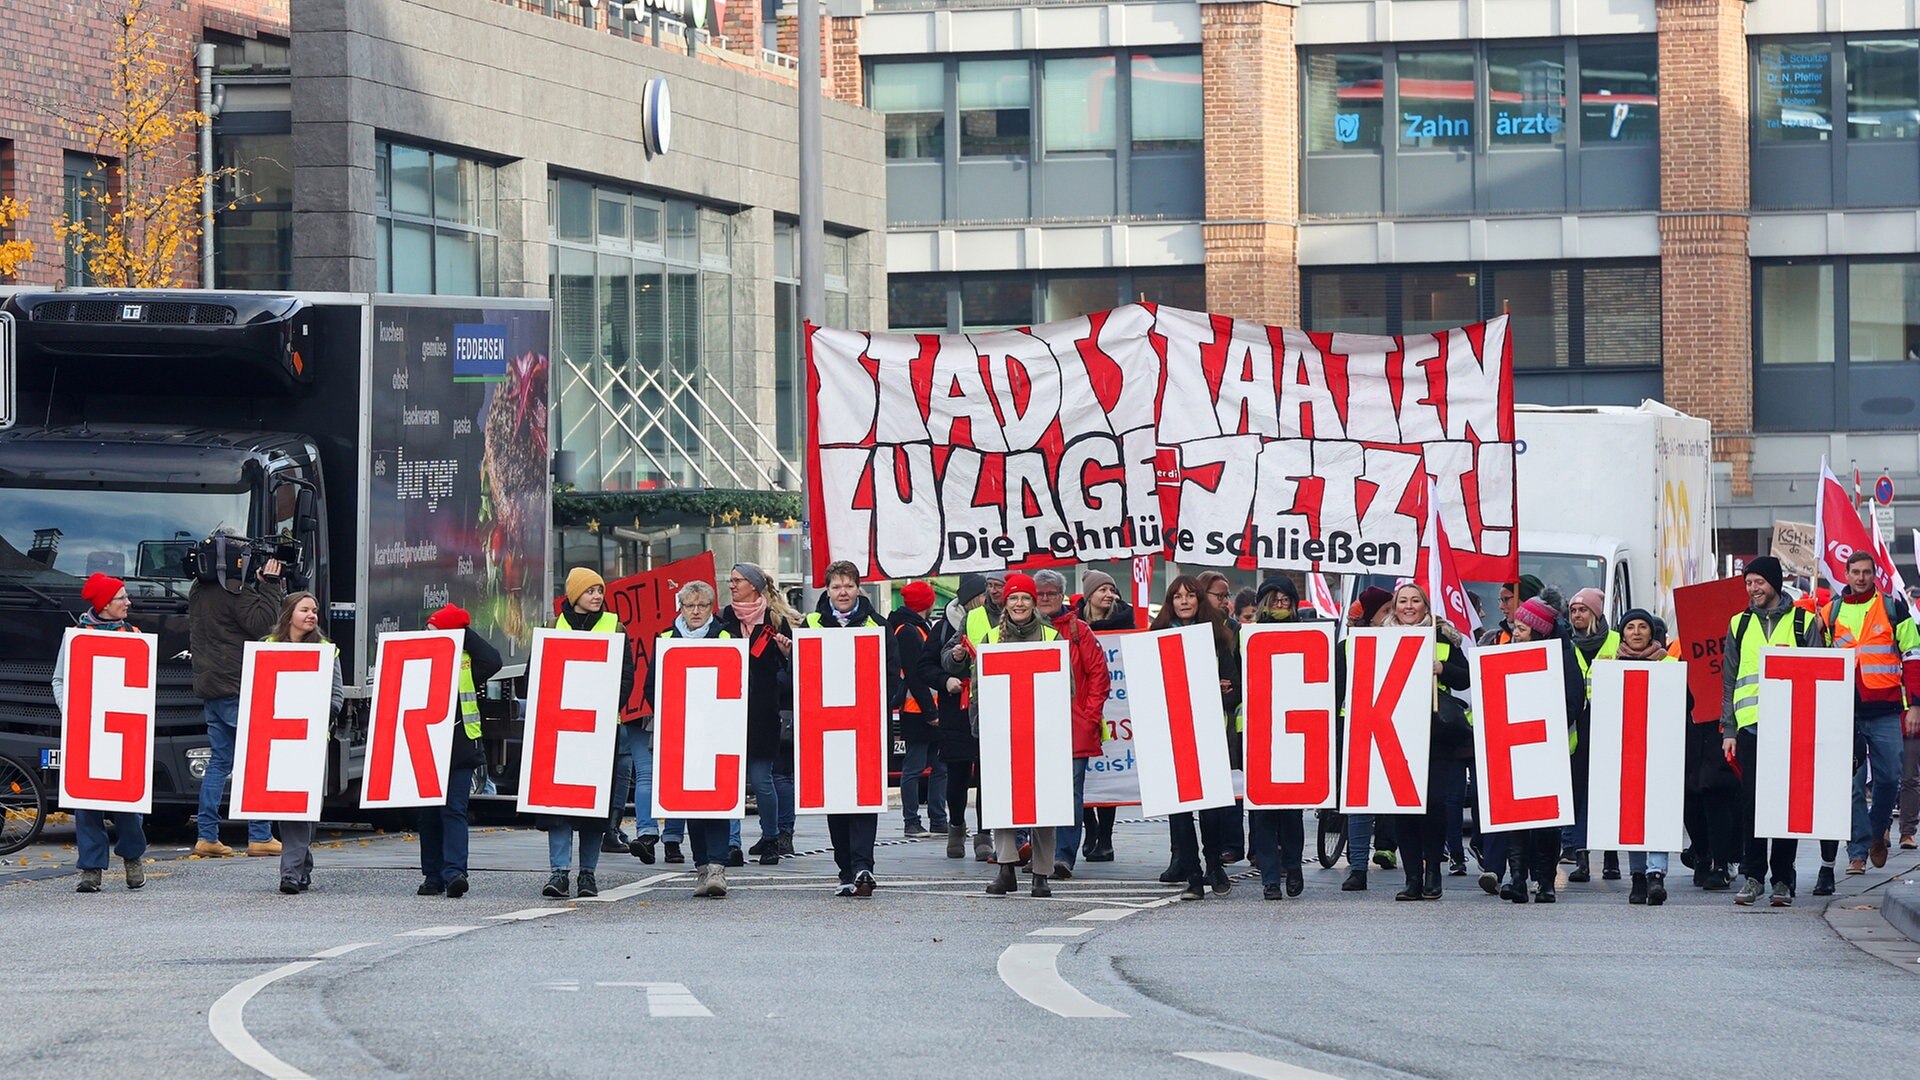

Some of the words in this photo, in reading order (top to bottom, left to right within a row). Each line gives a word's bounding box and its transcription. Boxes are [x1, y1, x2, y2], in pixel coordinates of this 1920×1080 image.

[1404, 112, 1470, 137] Zahn
[1496, 112, 1561, 136] ärzte
[379, 322, 404, 342] kuchen
[422, 337, 447, 361] gemüse
[456, 337, 504, 361] FEDDERSEN
[392, 367, 409, 390] obst
[403, 405, 440, 426] backwaren
[453, 416, 472, 439] pasta
[374, 453, 386, 476] eis
[397, 446, 459, 512] burger
[820, 428, 1159, 579] ZULAGE
[374, 540, 438, 568] kartoffelprodukte
[948, 527, 1015, 561] Die
[1206, 524, 1401, 567] schließen
[457, 556, 474, 576] fisch
[423, 583, 450, 609] fleisch
